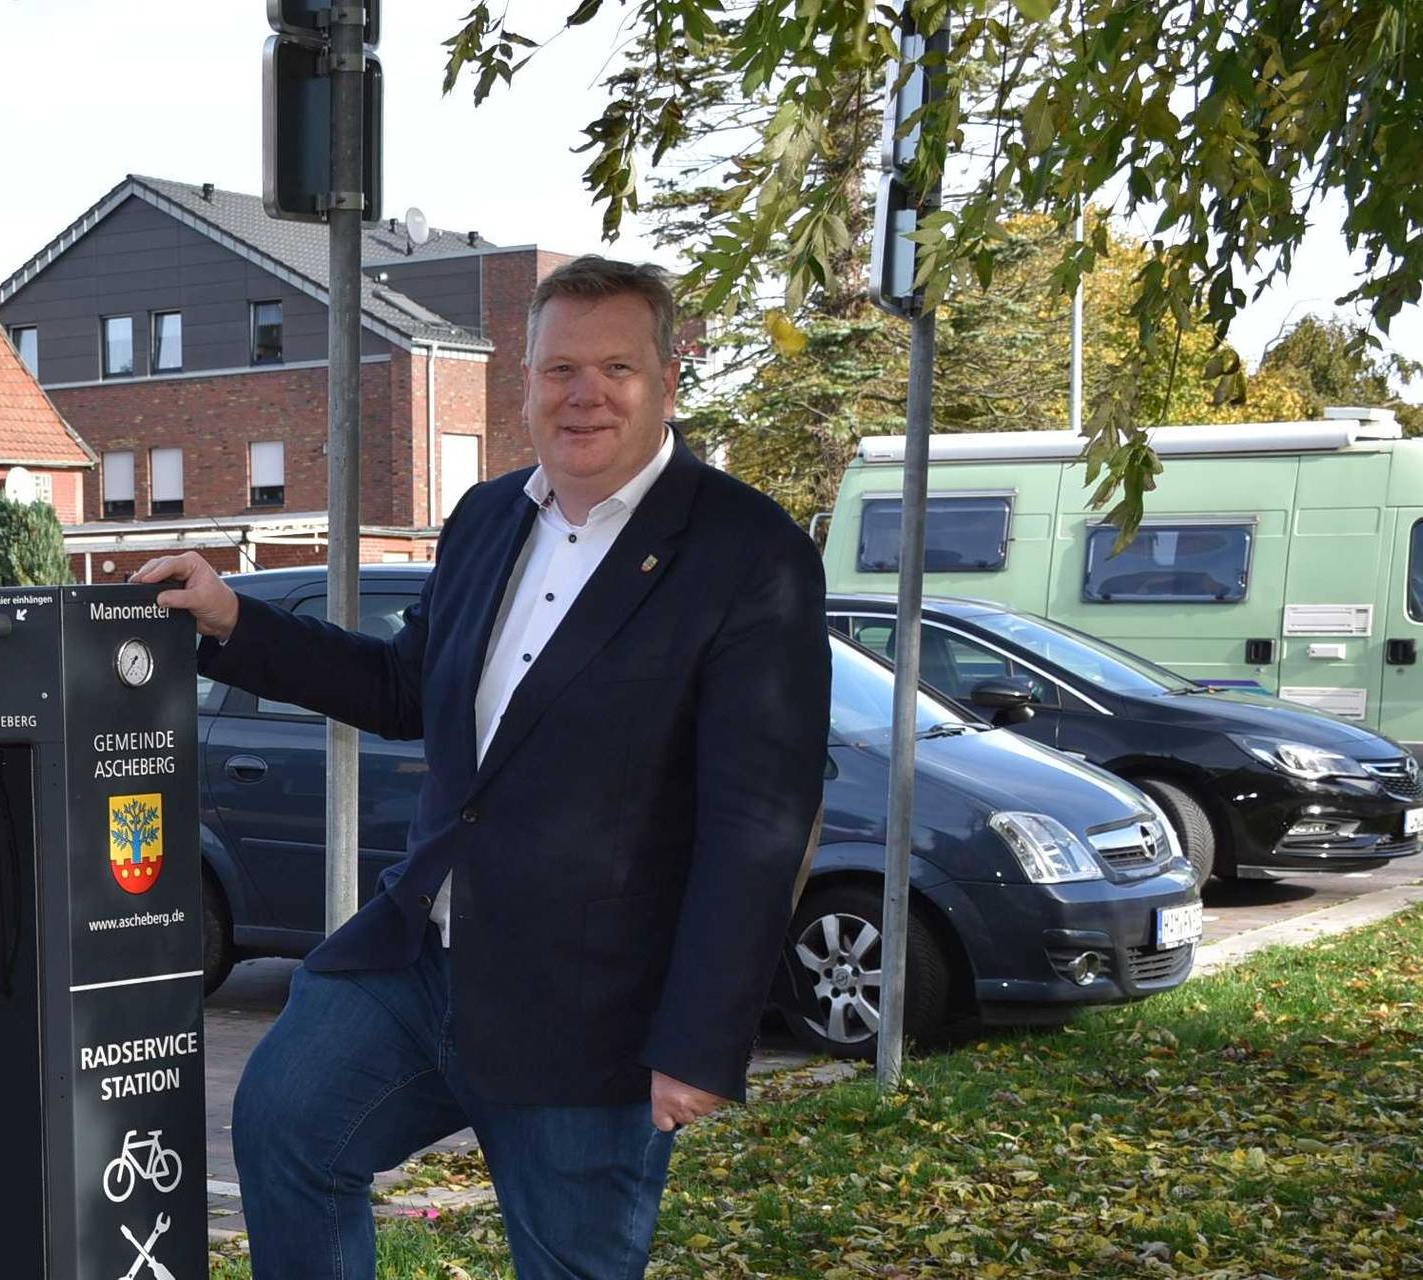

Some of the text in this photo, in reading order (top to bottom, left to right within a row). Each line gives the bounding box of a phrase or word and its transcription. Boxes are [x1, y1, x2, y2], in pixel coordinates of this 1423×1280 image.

[12, 595, 53, 606] einhängen
[93, 731, 174, 752] GEMEINDE
[94, 756, 175, 779] ASCHEBERG
[89, 909, 185, 932] www.ascheberg.de
[81, 1031, 198, 1070] RADSERVICE
[101, 1067, 180, 1101] STATION
